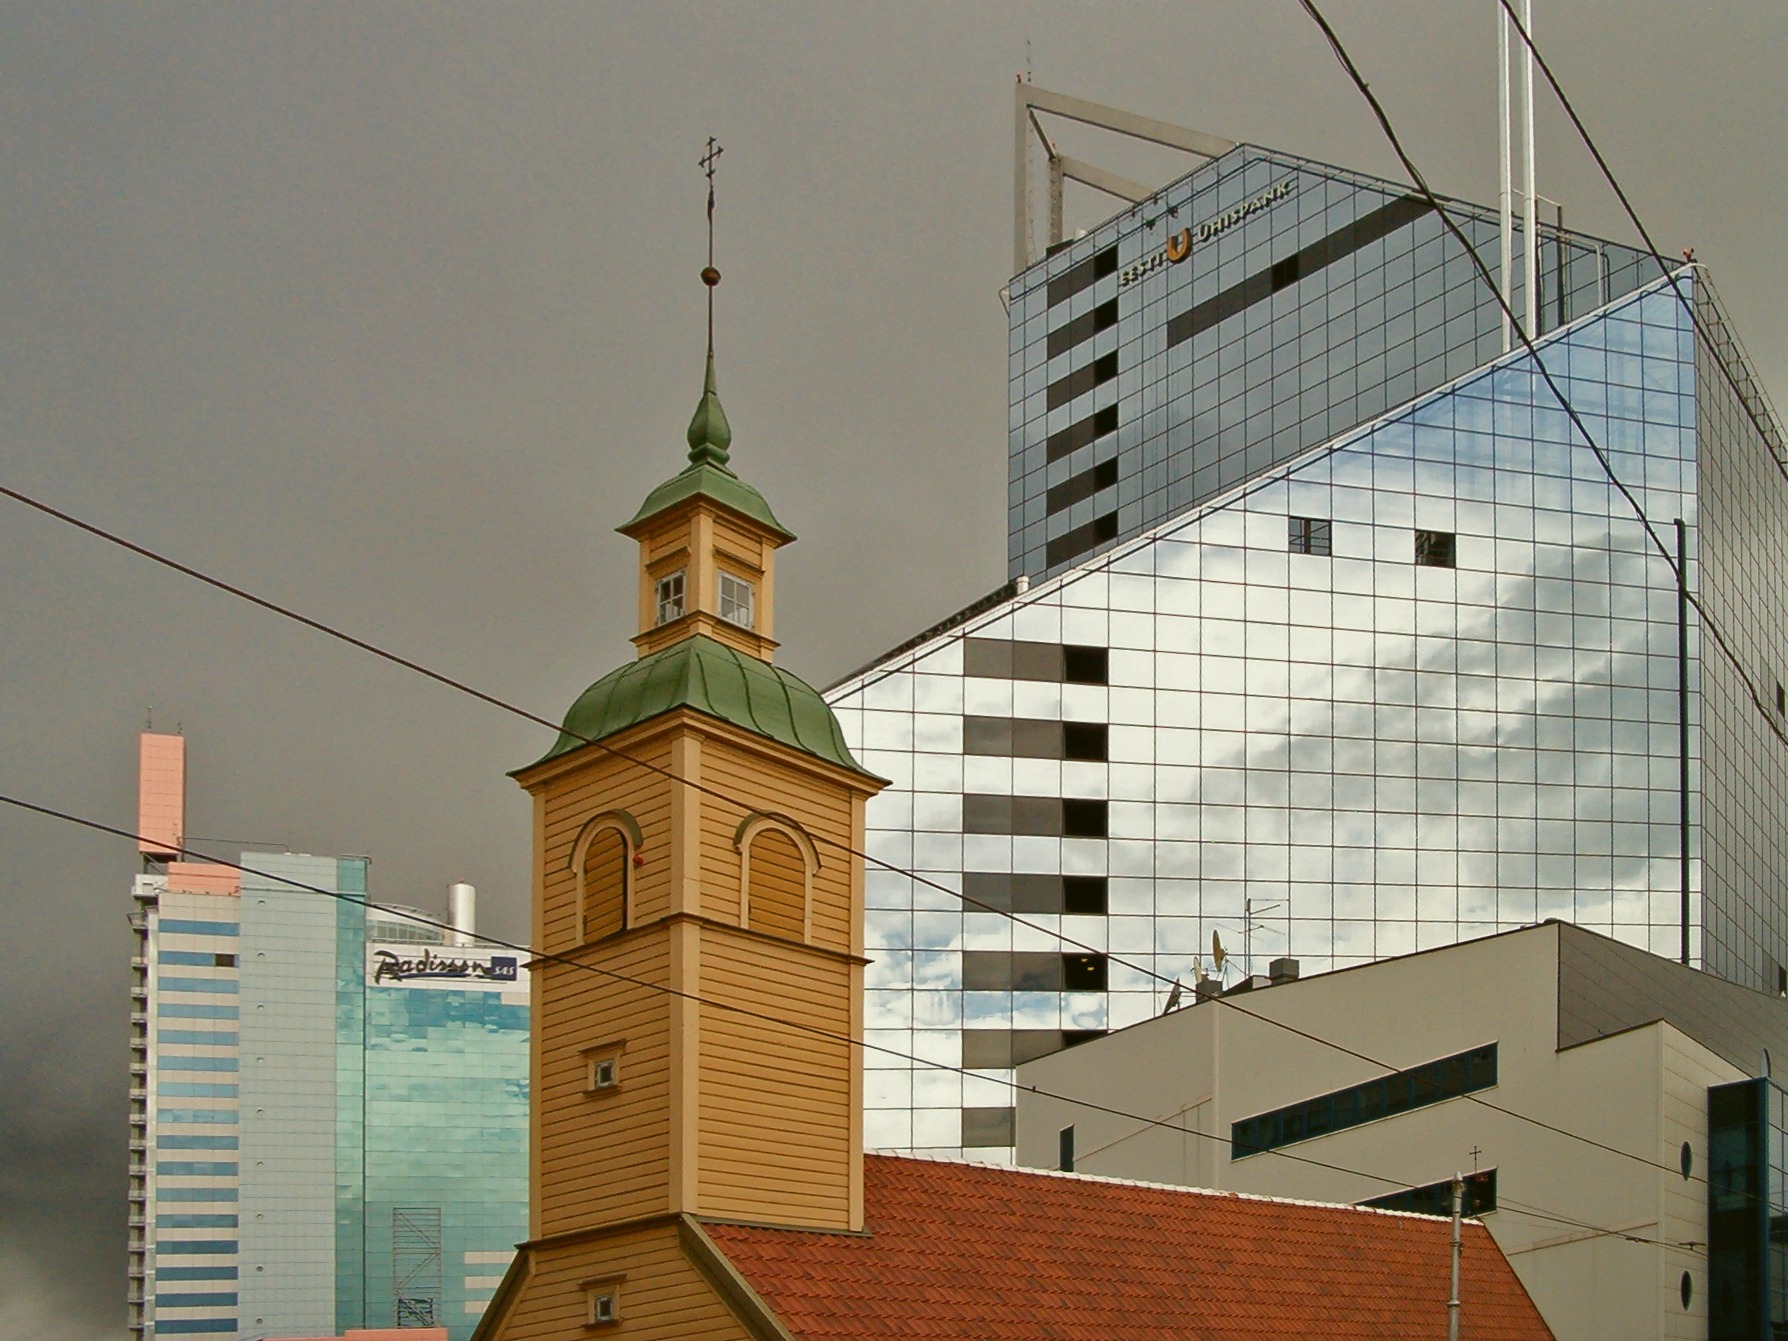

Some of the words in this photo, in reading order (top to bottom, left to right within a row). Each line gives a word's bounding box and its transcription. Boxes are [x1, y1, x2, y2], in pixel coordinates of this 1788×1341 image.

[1119, 250, 1166, 287] EESTI
[374, 948, 492, 985] Radisson
[493, 964, 516, 976] SAS
